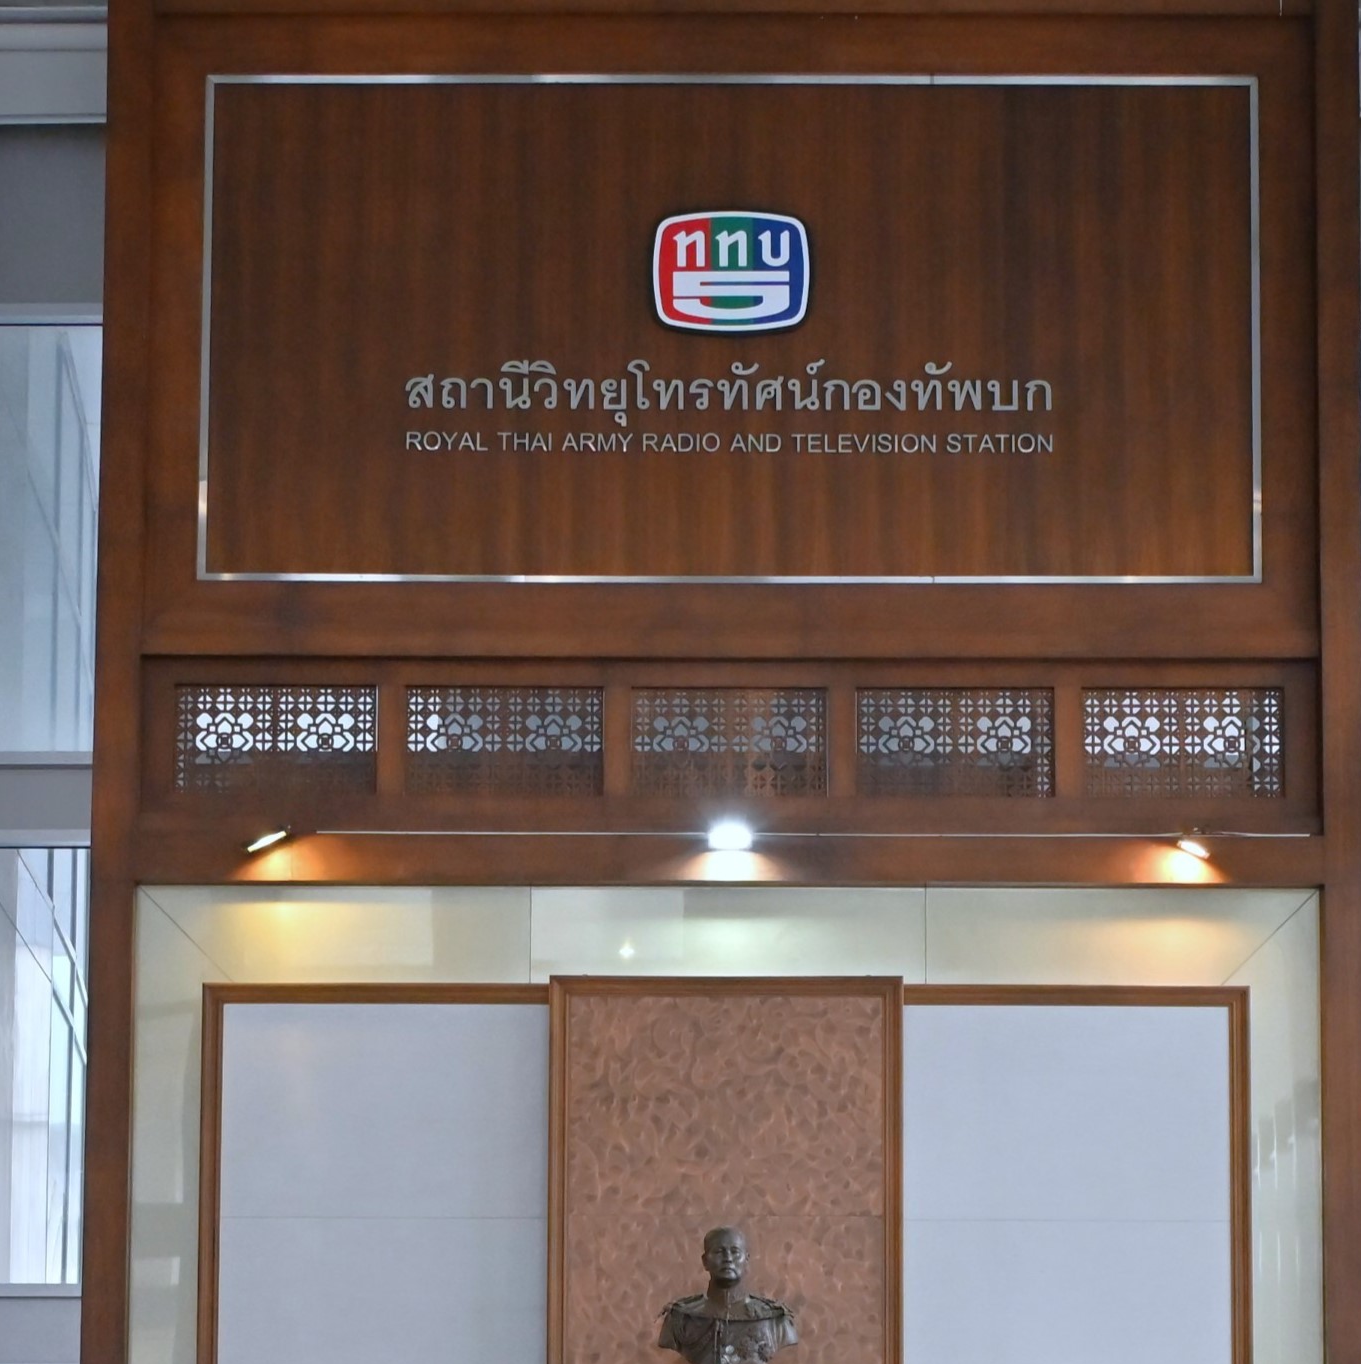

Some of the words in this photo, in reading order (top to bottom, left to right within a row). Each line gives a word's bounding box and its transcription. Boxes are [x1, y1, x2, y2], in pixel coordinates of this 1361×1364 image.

[672, 229, 790, 268] ททบ
[672, 270, 790, 321] 5
[404, 358, 1053, 428] สถานีวิทยุโทรทัศน์กองทัพบก
[405, 431, 489, 452] ROYAL
[497, 431, 553, 453] THAI
[561, 431, 634, 453] ARMY
[642, 432, 721, 453] RADIO
[730, 433, 783, 454] AND
[791, 433, 937, 454] TELEVISION
[946, 433, 1054, 454] STATION
